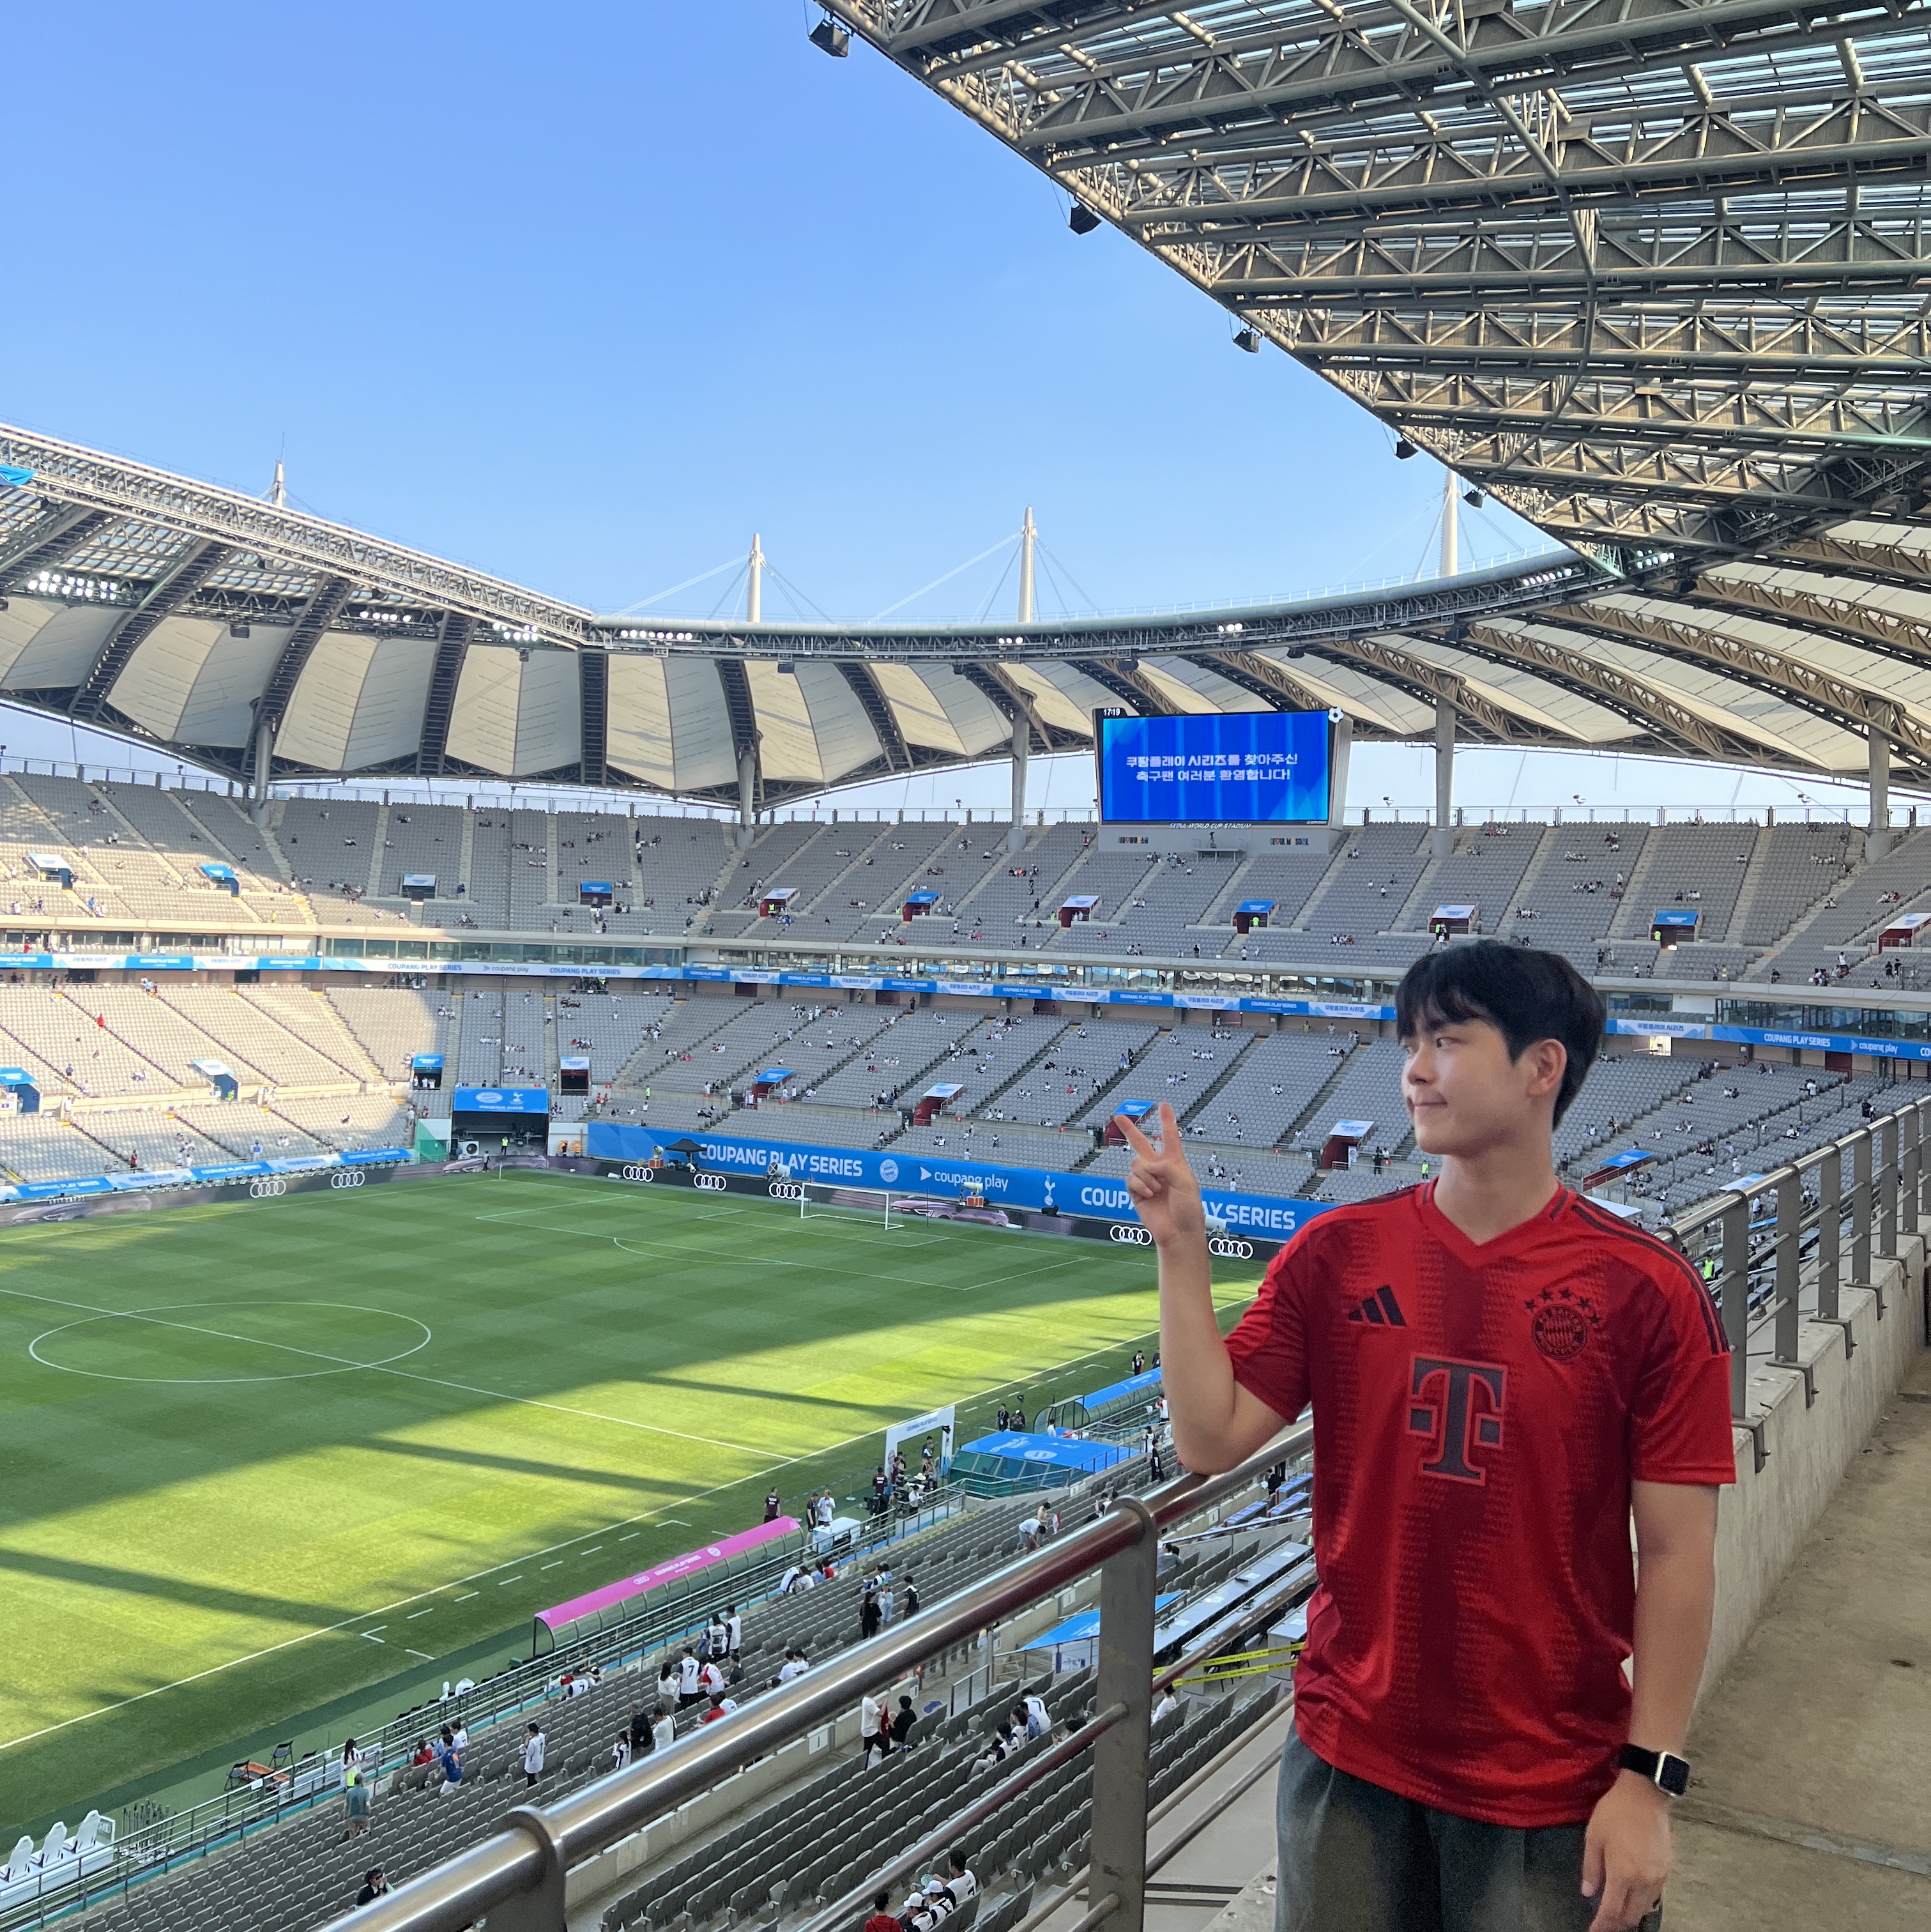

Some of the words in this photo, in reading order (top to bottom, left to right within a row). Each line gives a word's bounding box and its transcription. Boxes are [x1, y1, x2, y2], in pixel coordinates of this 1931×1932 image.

[1103, 708, 1121, 716] 17:19
[1126, 756, 1186, 767] 쿠팡플레이
[1187, 755, 1240, 767] 시리즈를
[1244, 753, 1298, 765] 찾아주신
[1136, 770, 1174, 782] 축구팬
[1177, 770, 1216, 781] 여러분
[1219, 769, 1291, 781] 환영합니다!
[1764, 1033, 1792, 1043] COUPANG
[1792, 1035, 1809, 1045] PLAY
[1808, 1037, 1831, 1046] SERIES
[1859, 1042, 1884, 1053] coupang
[1884, 1043, 1898, 1054] play
[699, 1143, 767, 1166] COUPANG
[810, 1155, 863, 1177] SERIES
[935, 1170, 982, 1187] coupang
[985, 1174, 1009, 1192] play
[1081, 1187, 1135, 1210] COUP
[1225, 1204, 1295, 1230] SERIES
[688, 1664, 695, 1676] 7
[1032, 1700, 1041, 1712] 7
